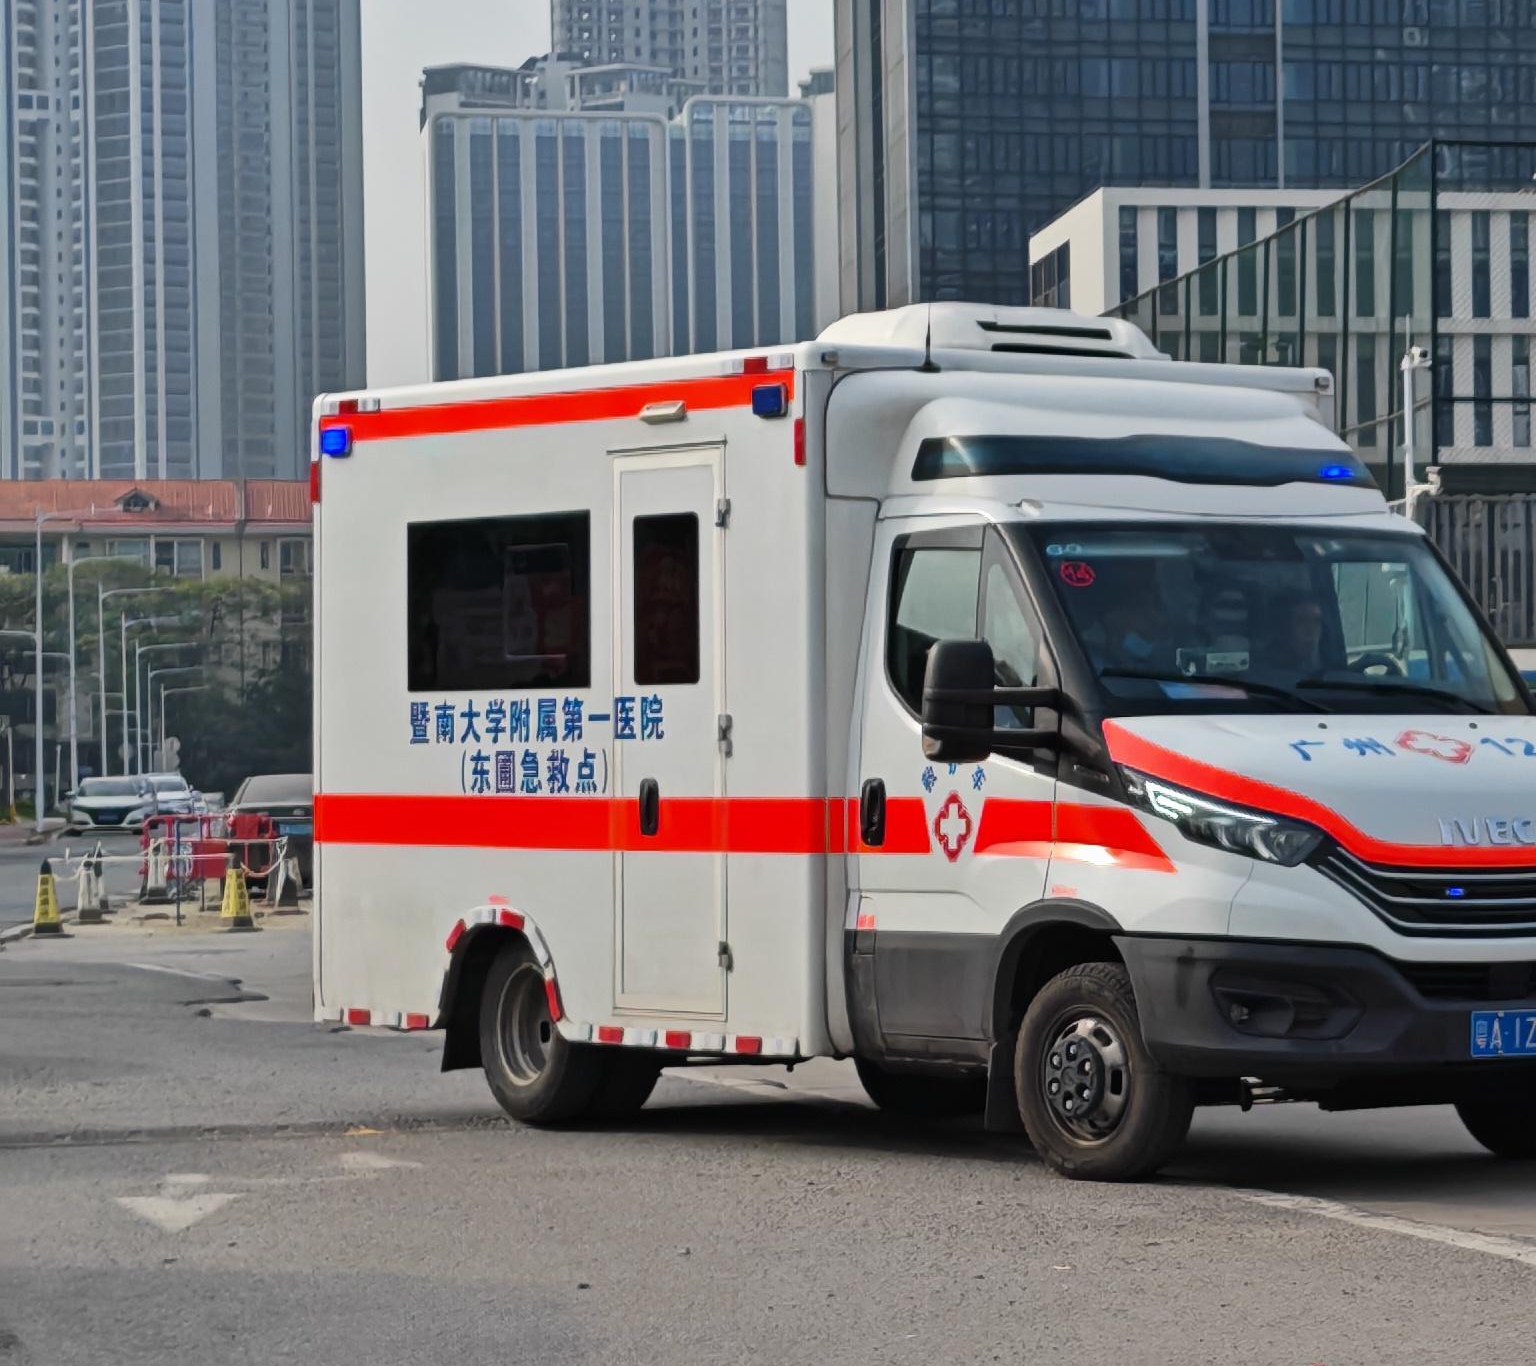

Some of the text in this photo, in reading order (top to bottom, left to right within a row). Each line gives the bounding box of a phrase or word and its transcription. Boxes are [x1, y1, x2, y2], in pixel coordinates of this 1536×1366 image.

[409, 693, 665, 744] 暨南大学附属第一医院
